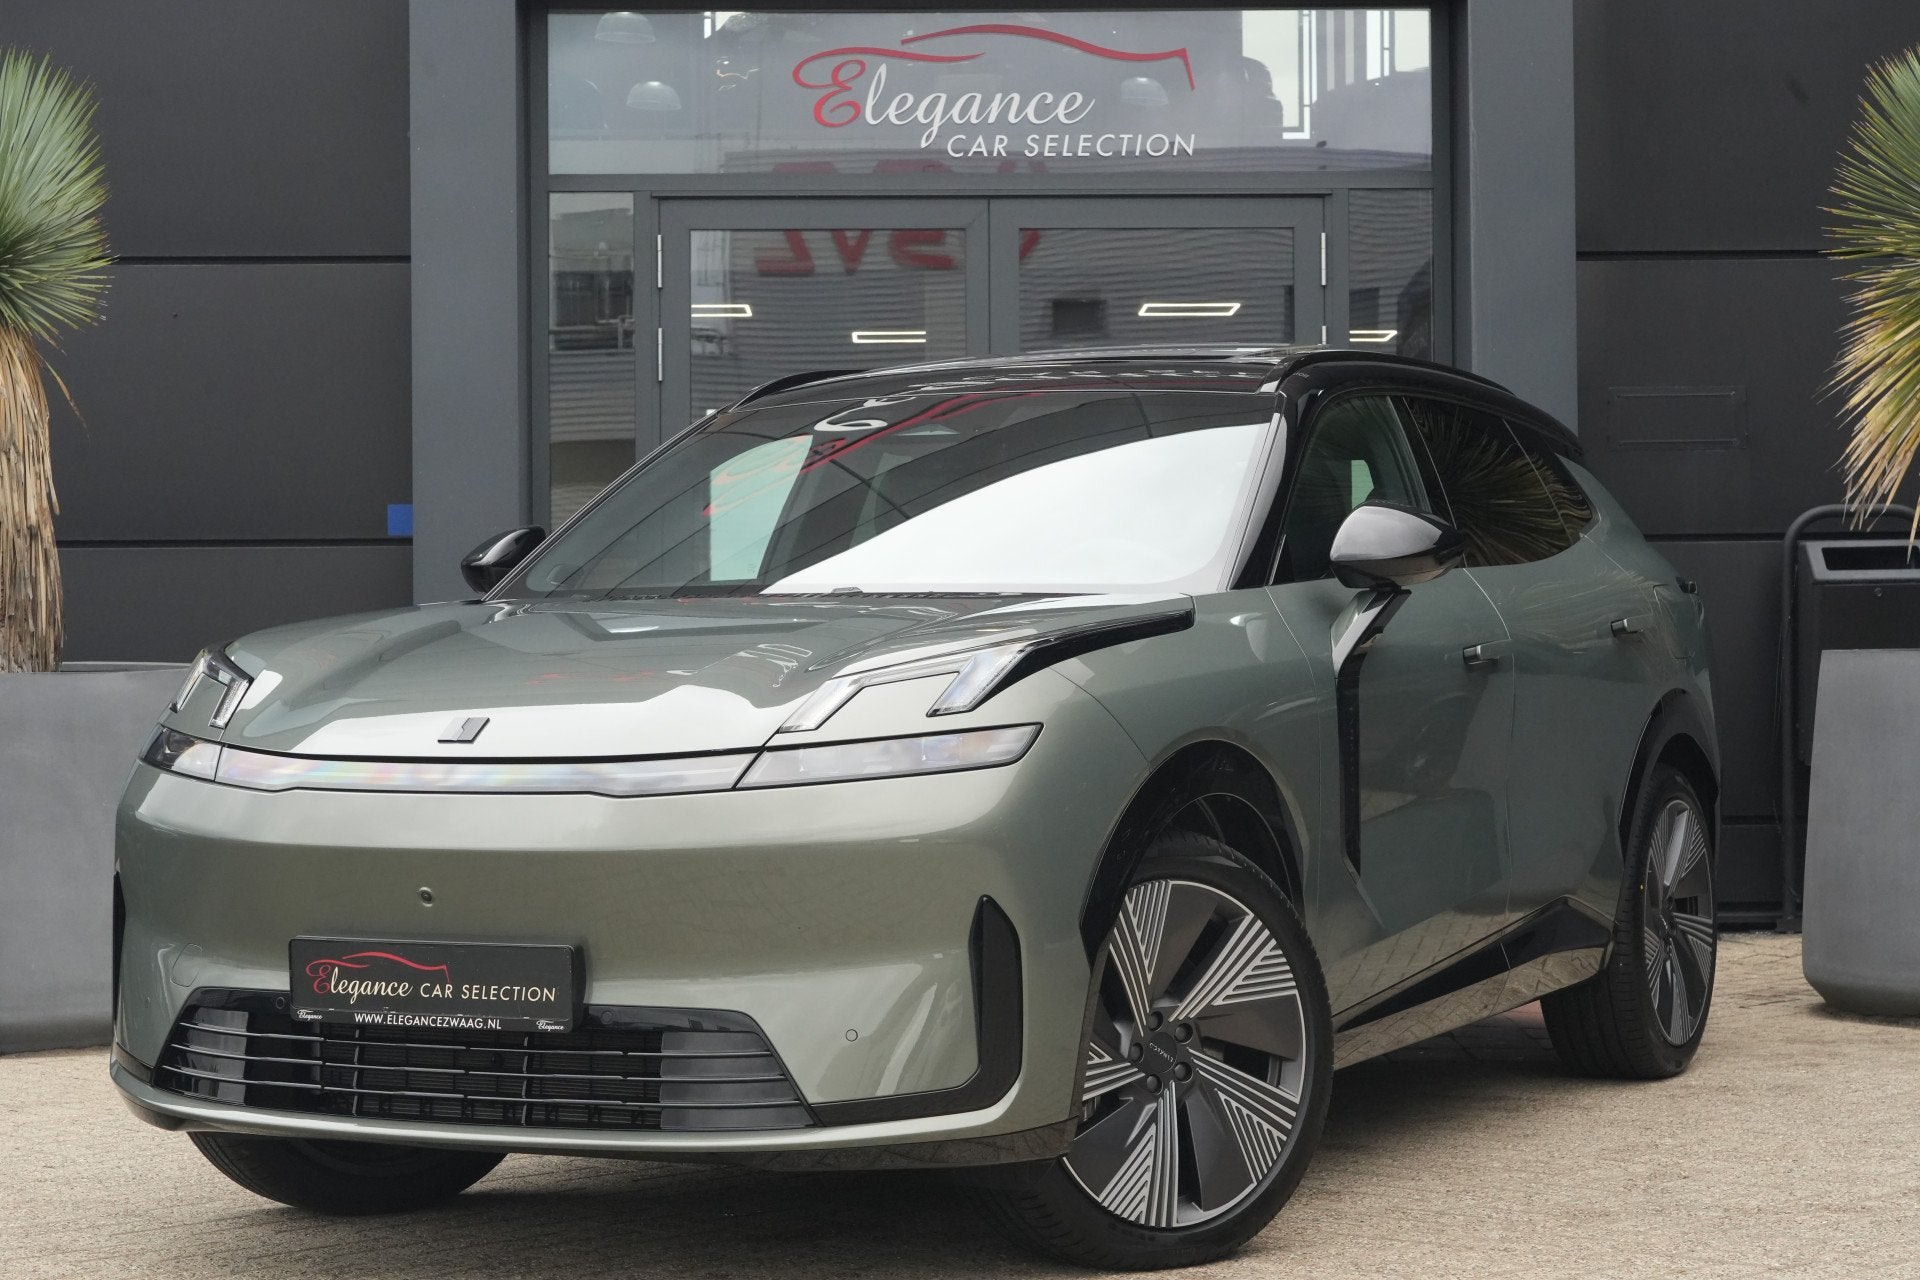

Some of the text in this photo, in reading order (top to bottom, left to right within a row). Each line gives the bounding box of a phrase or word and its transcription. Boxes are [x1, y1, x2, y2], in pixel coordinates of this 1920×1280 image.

[793, 47, 1096, 149] Elegance
[947, 133, 1196, 158] CAR SELECTION
[306, 959, 556, 1005] Elegance CAR SELECTION
[354, 1013, 502, 1030] WWW.ELEGANCEZWAAG.NL
